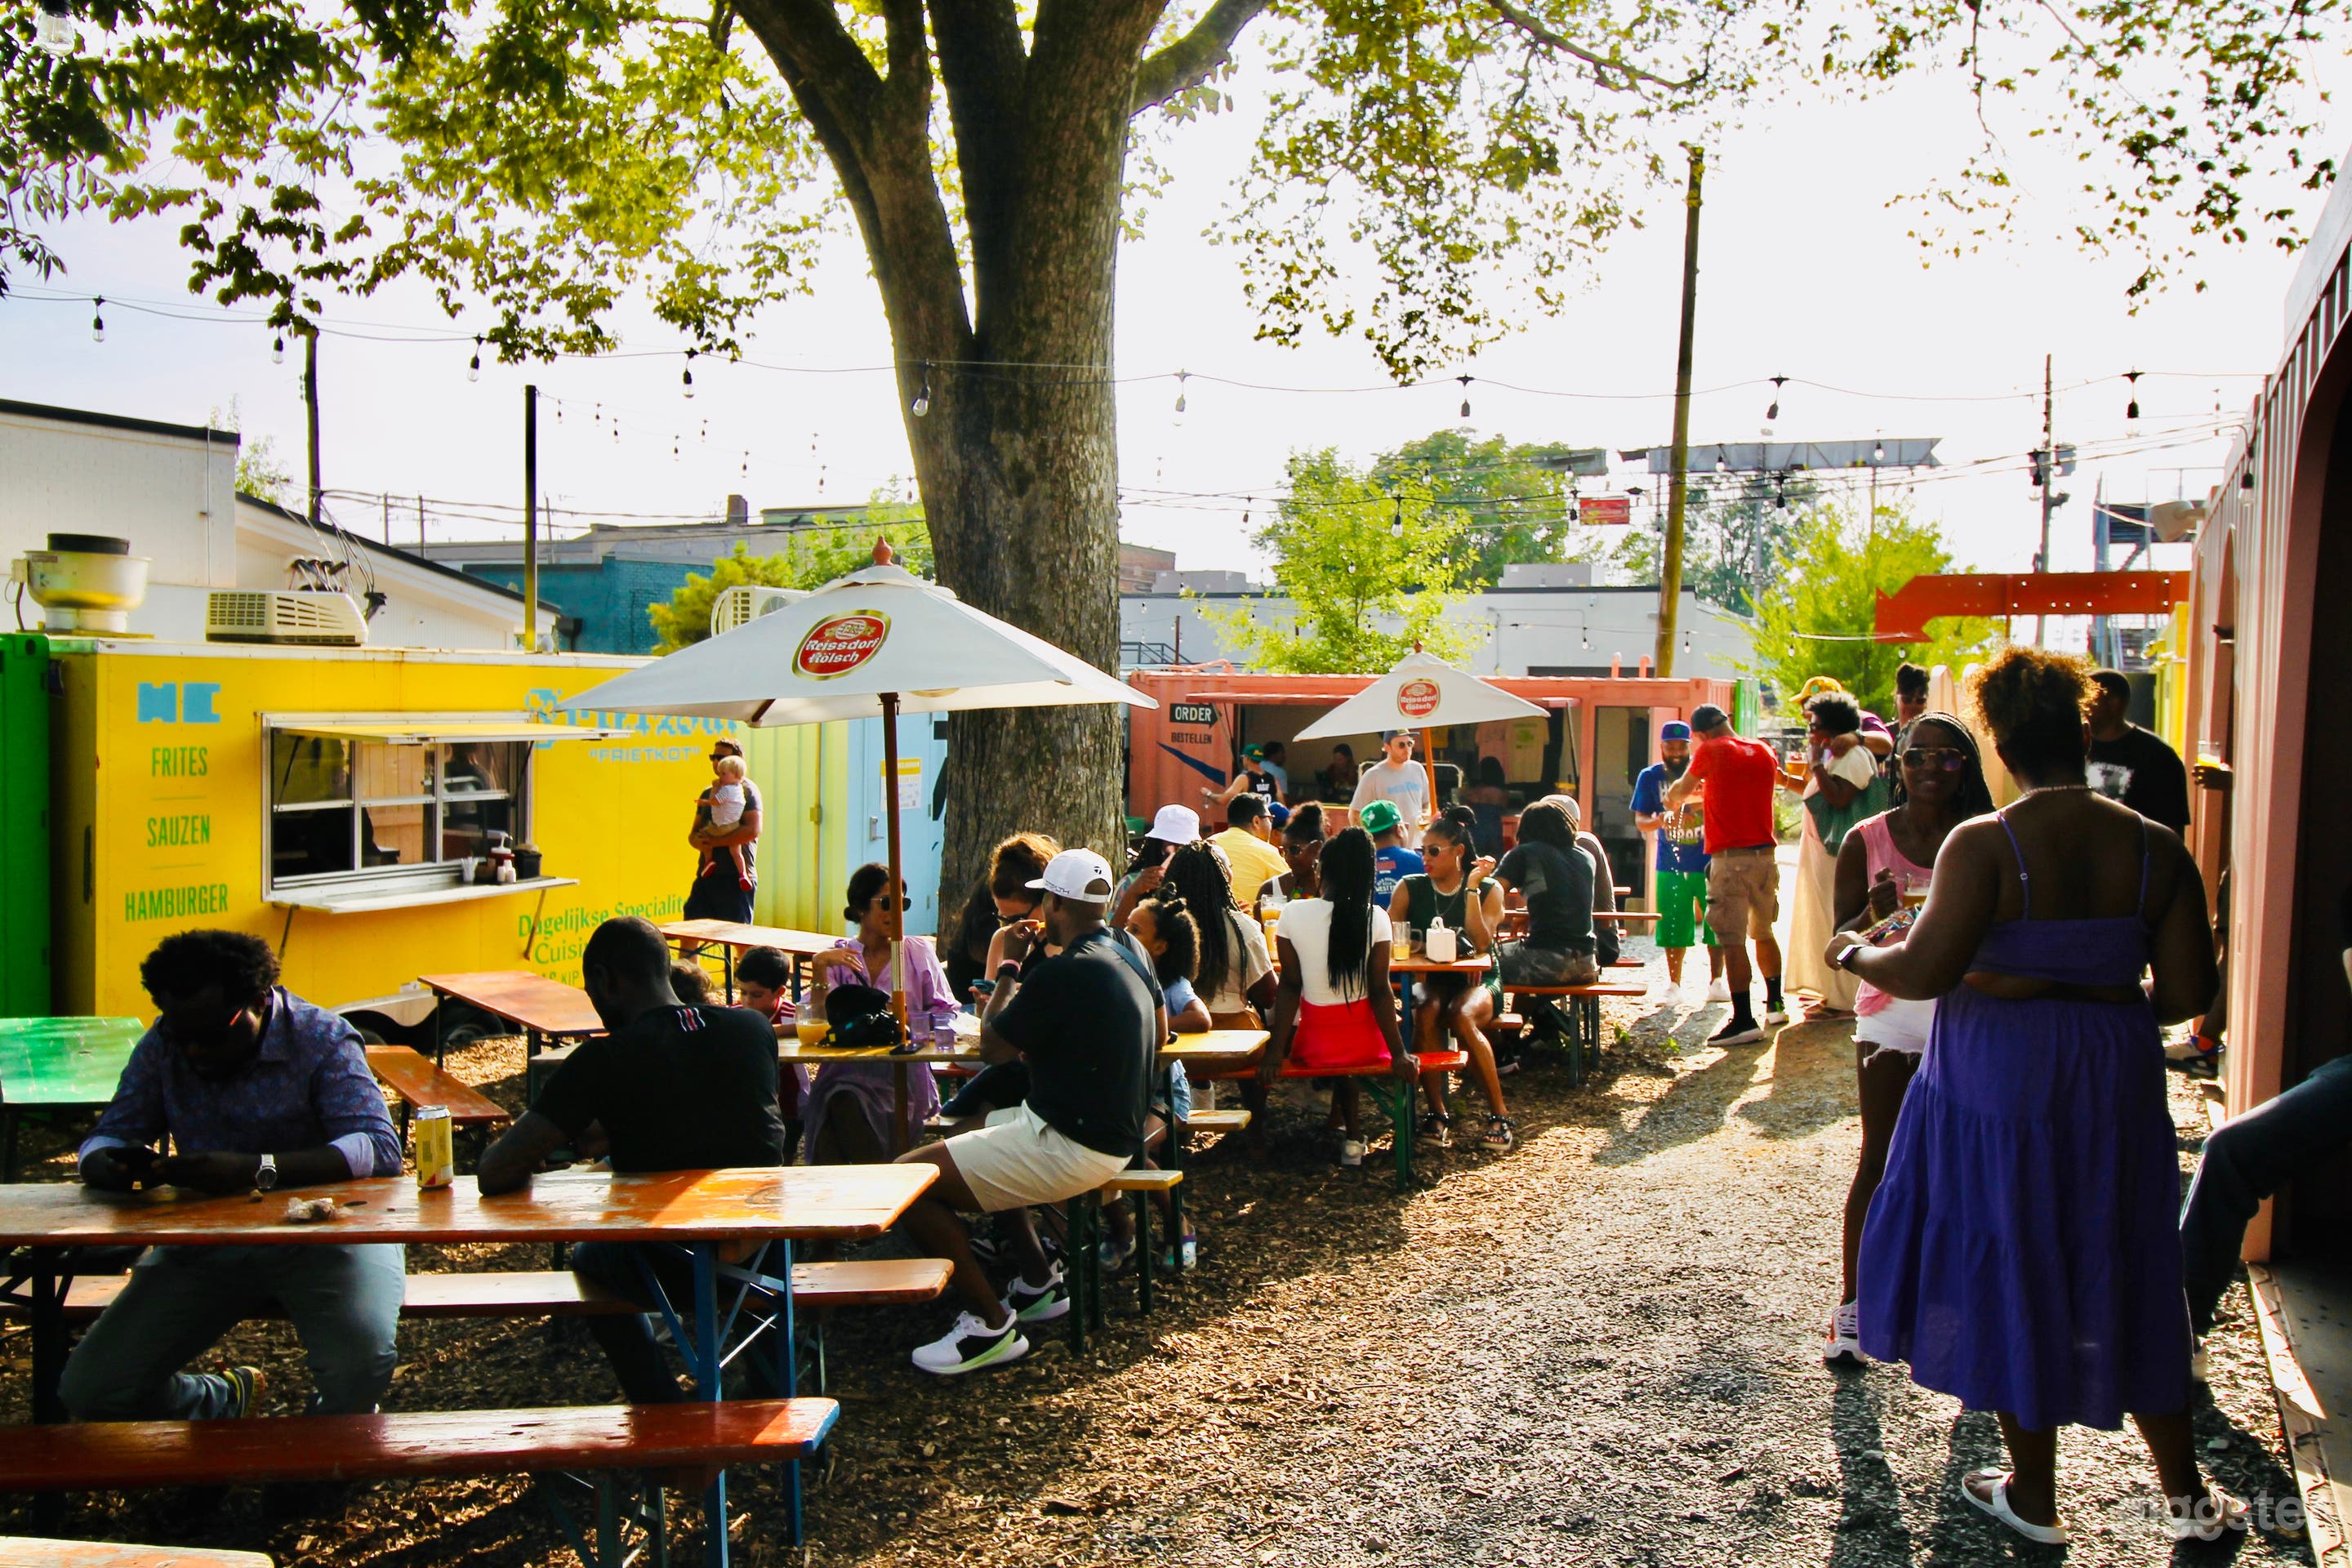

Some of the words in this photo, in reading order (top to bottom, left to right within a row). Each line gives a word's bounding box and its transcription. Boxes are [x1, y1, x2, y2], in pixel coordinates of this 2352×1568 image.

[805, 637, 880, 651] Reissdorf
[1174, 706, 1212, 722] ORDER
[1171, 732, 1212, 744] BESTELLEN
[151, 746, 208, 777] FRITES
[147, 815, 211, 848] SAUZEN
[125, 883, 229, 922] HAMBURGER
[615, 894, 688, 918] Specialit
[534, 937, 587, 964] Cuisi
